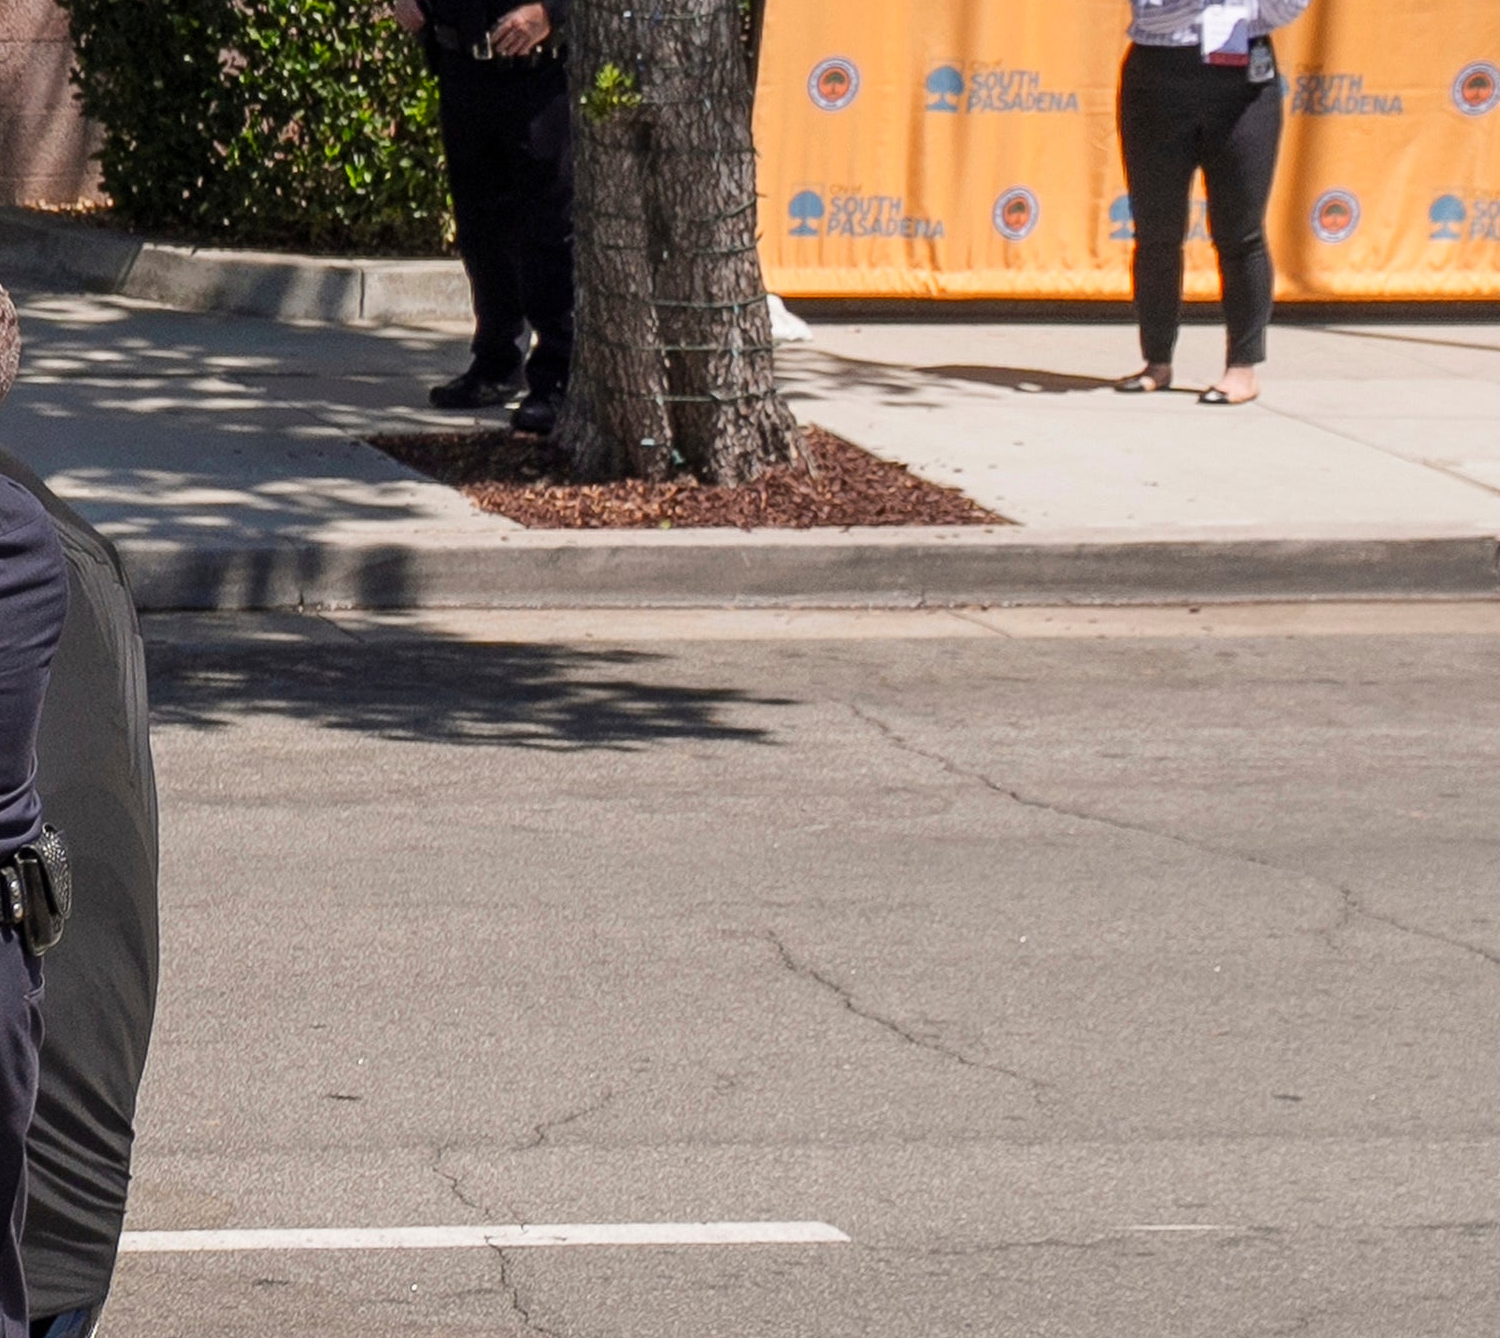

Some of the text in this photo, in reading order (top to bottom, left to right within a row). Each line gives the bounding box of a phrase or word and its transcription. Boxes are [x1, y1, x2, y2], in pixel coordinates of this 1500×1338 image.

[971, 69, 1040, 91] SOUTH
[1296, 73, 1364, 93] SOUTH
[967, 90, 1080, 114] PASADENA
[1292, 92, 1405, 115] PASADENA
[830, 195, 904, 216] SOUTH
[827, 214, 946, 240] PASADENA
